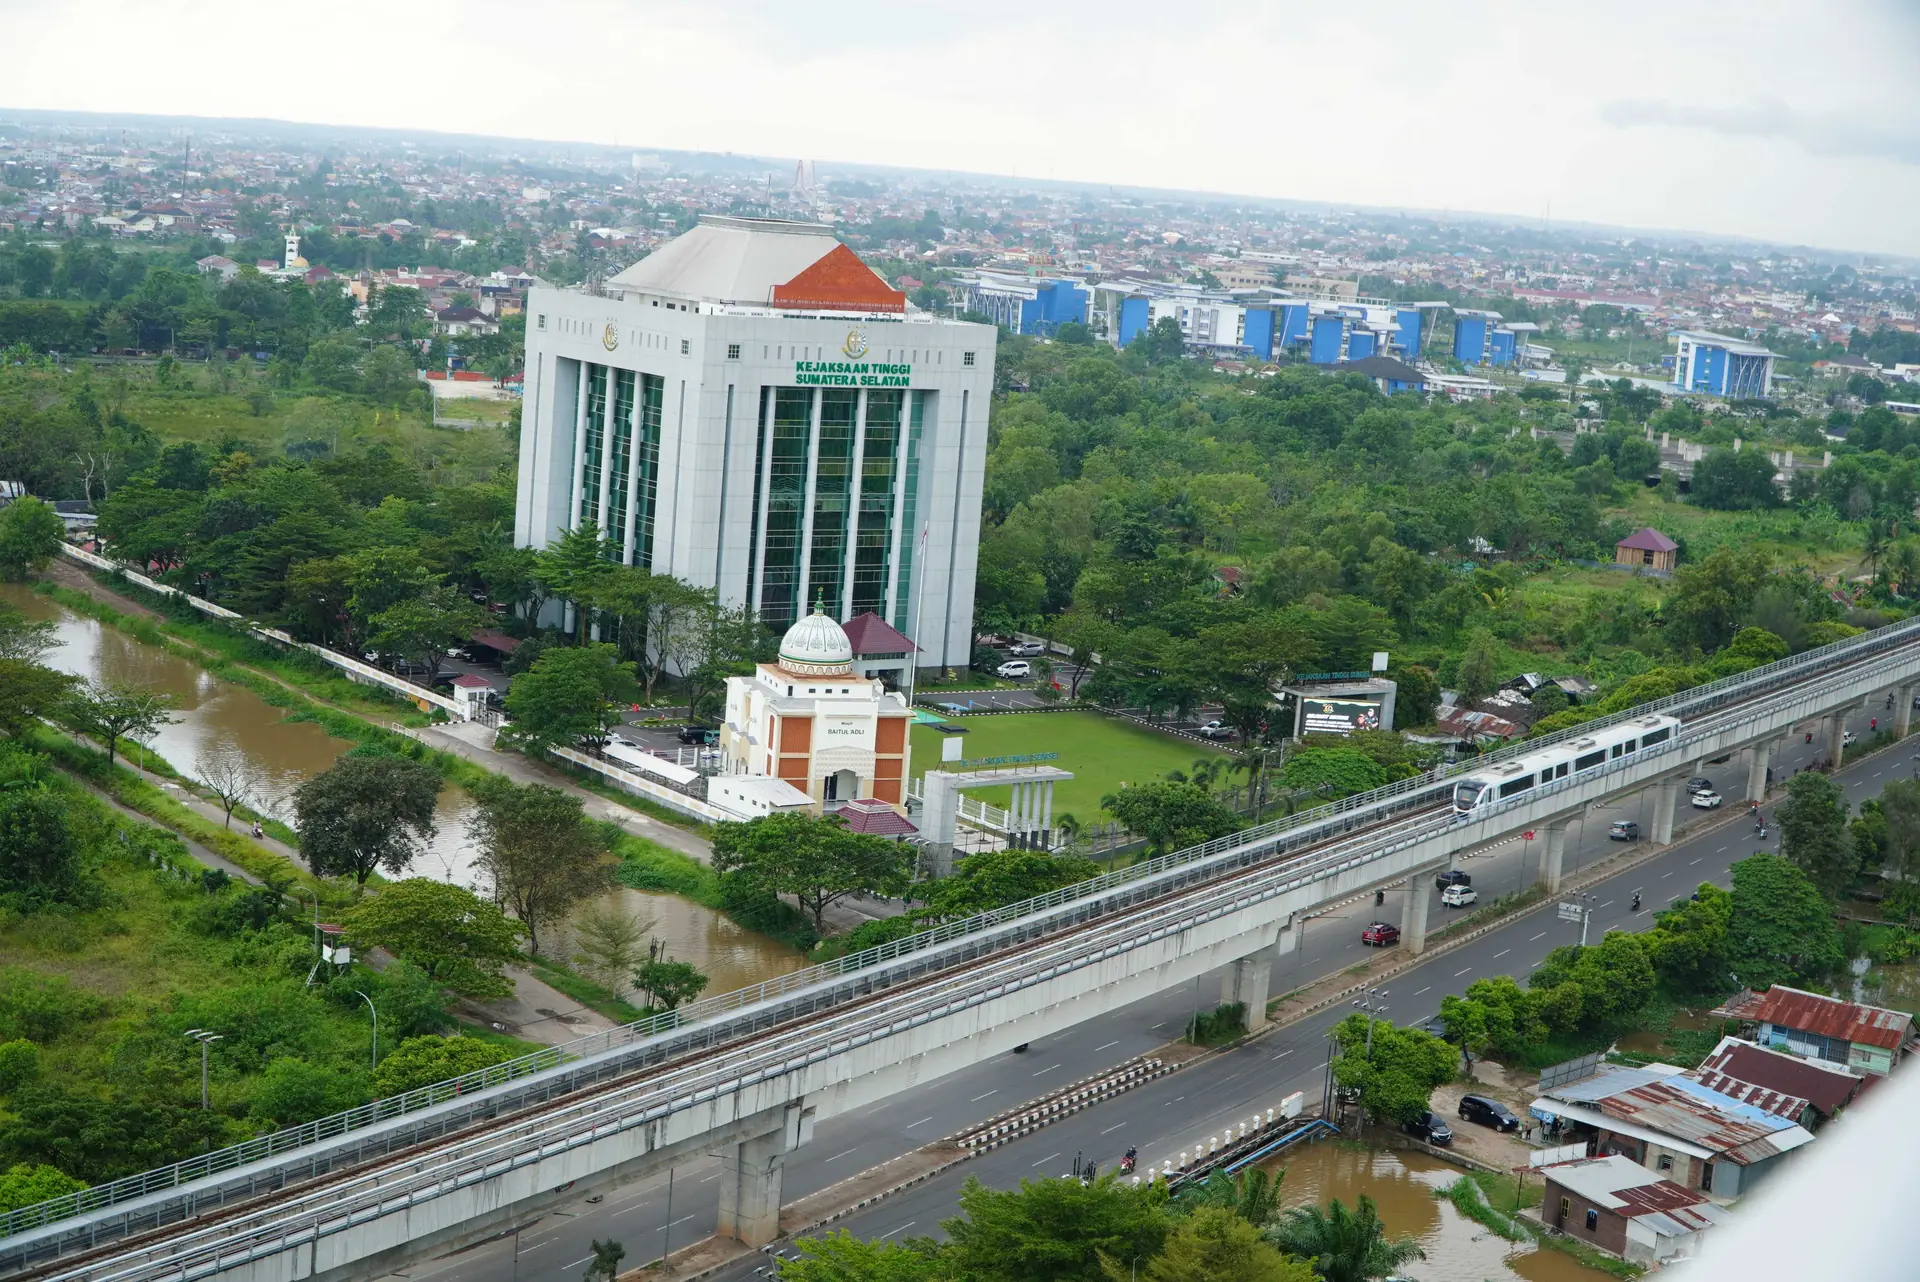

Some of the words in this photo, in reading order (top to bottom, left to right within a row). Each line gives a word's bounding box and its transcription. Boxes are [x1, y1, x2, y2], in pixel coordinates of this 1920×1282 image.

[796, 362, 869, 374] KEJAKSAAN
[872, 363, 911, 375] TINGGI
[795, 374, 857, 385] SUMATERA
[860, 375, 910, 387] SELATAN
